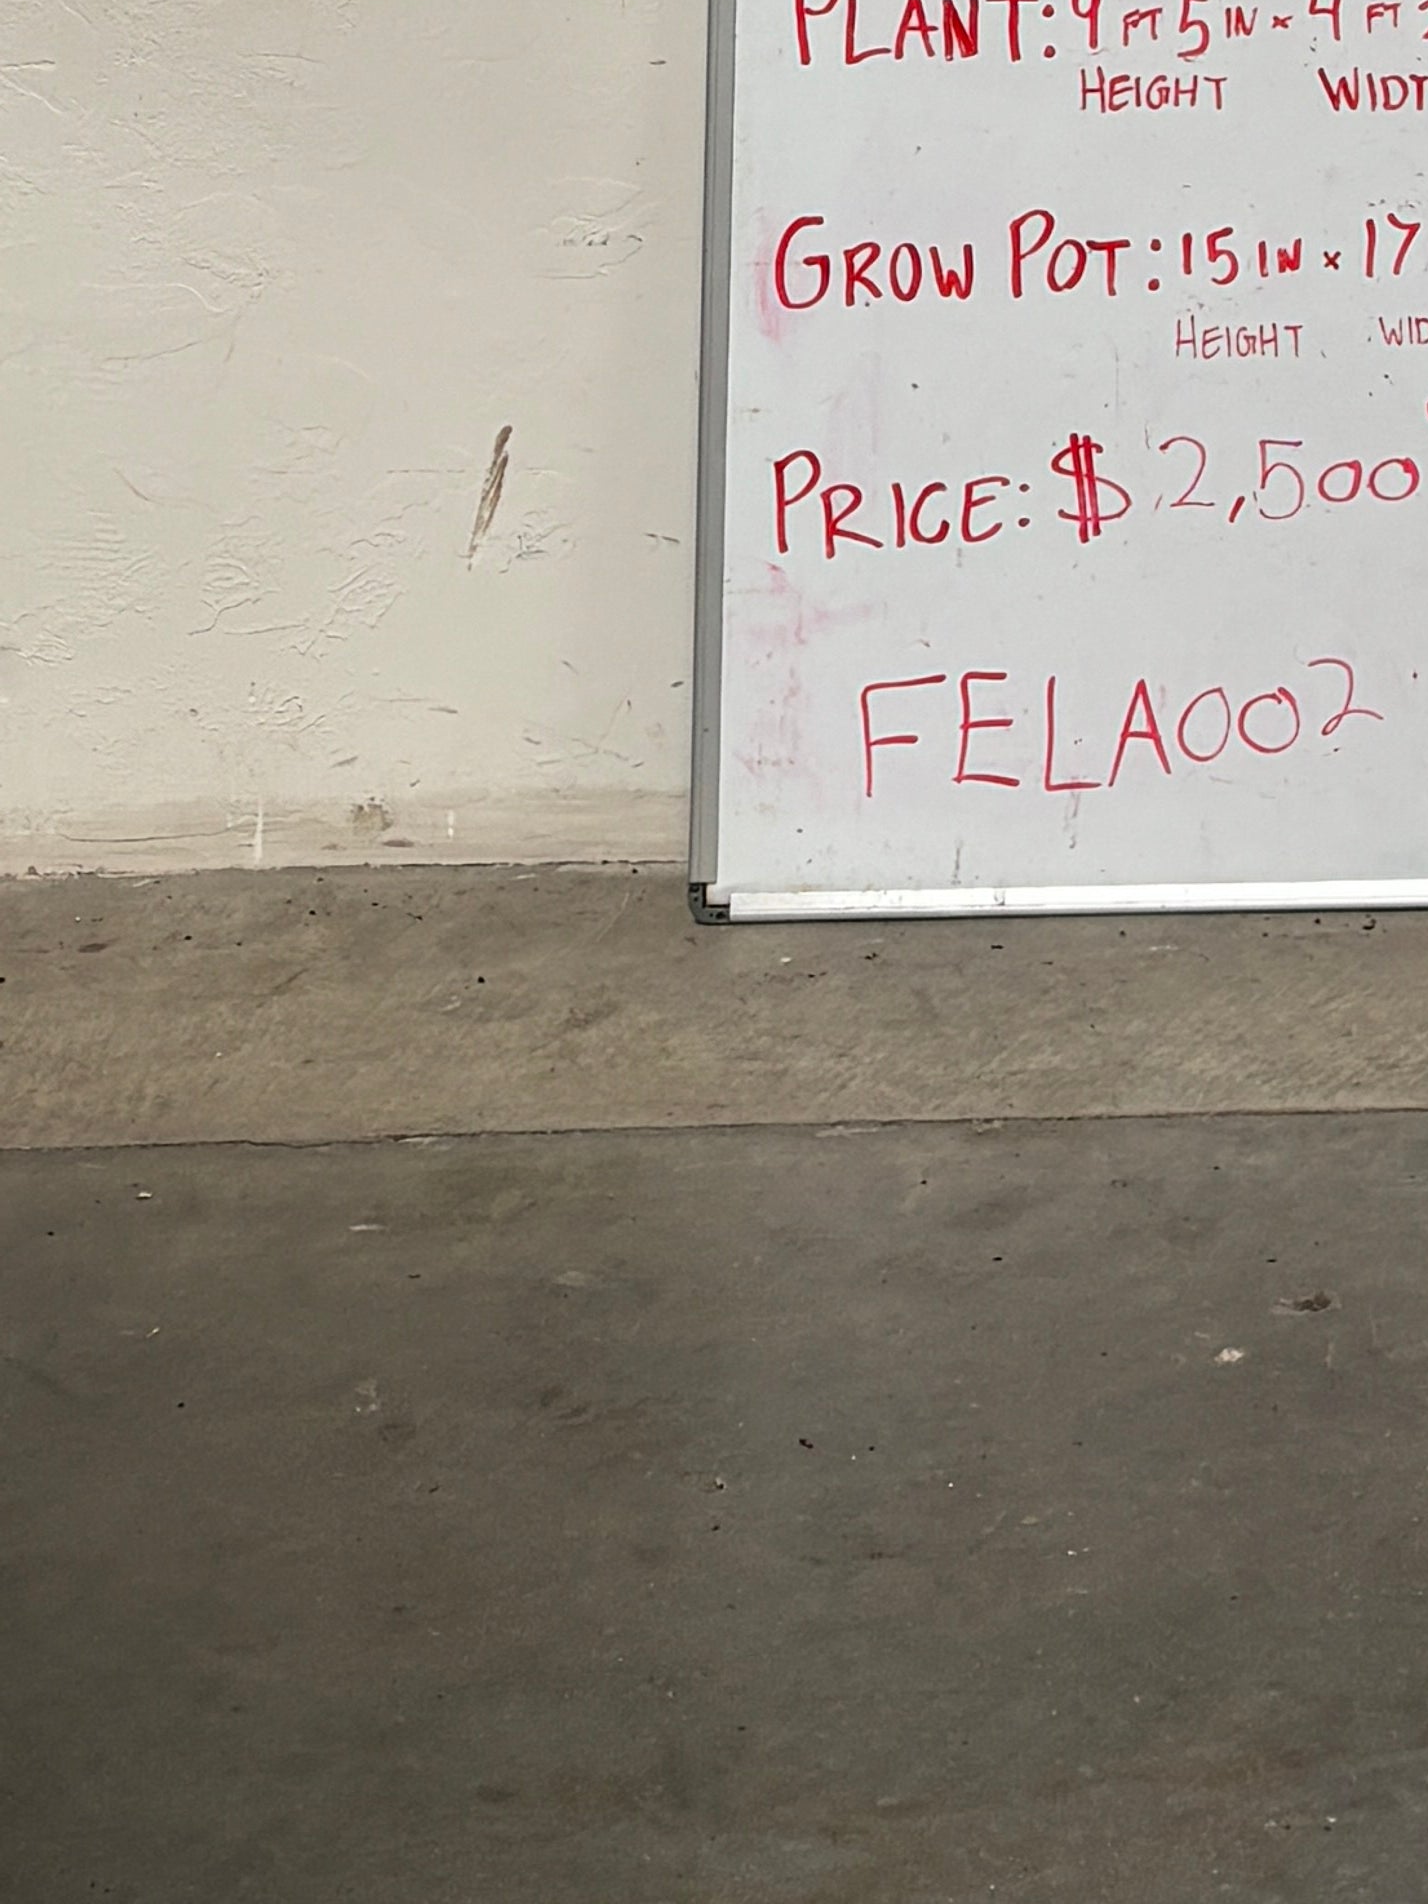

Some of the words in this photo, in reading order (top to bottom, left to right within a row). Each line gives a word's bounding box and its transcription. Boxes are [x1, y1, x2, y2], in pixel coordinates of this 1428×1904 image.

[1121, 7, 1163, 45] FT
[1223, 5, 1260, 38] IN
[1365, 1, 1403, 30] FT
[1080, 68, 1228, 113] HEIGHT
[772, 215, 975, 311] GROW
[1180, 227, 1240, 287] 15
[1256, 239, 1303, 279] IN
[1363, 212, 1422, 279] 17
[1174, 314, 1304, 360] HEIGHT
[773, 448, 1032, 560] PRICE:
[859, 657, 1386, 798] FELA002
